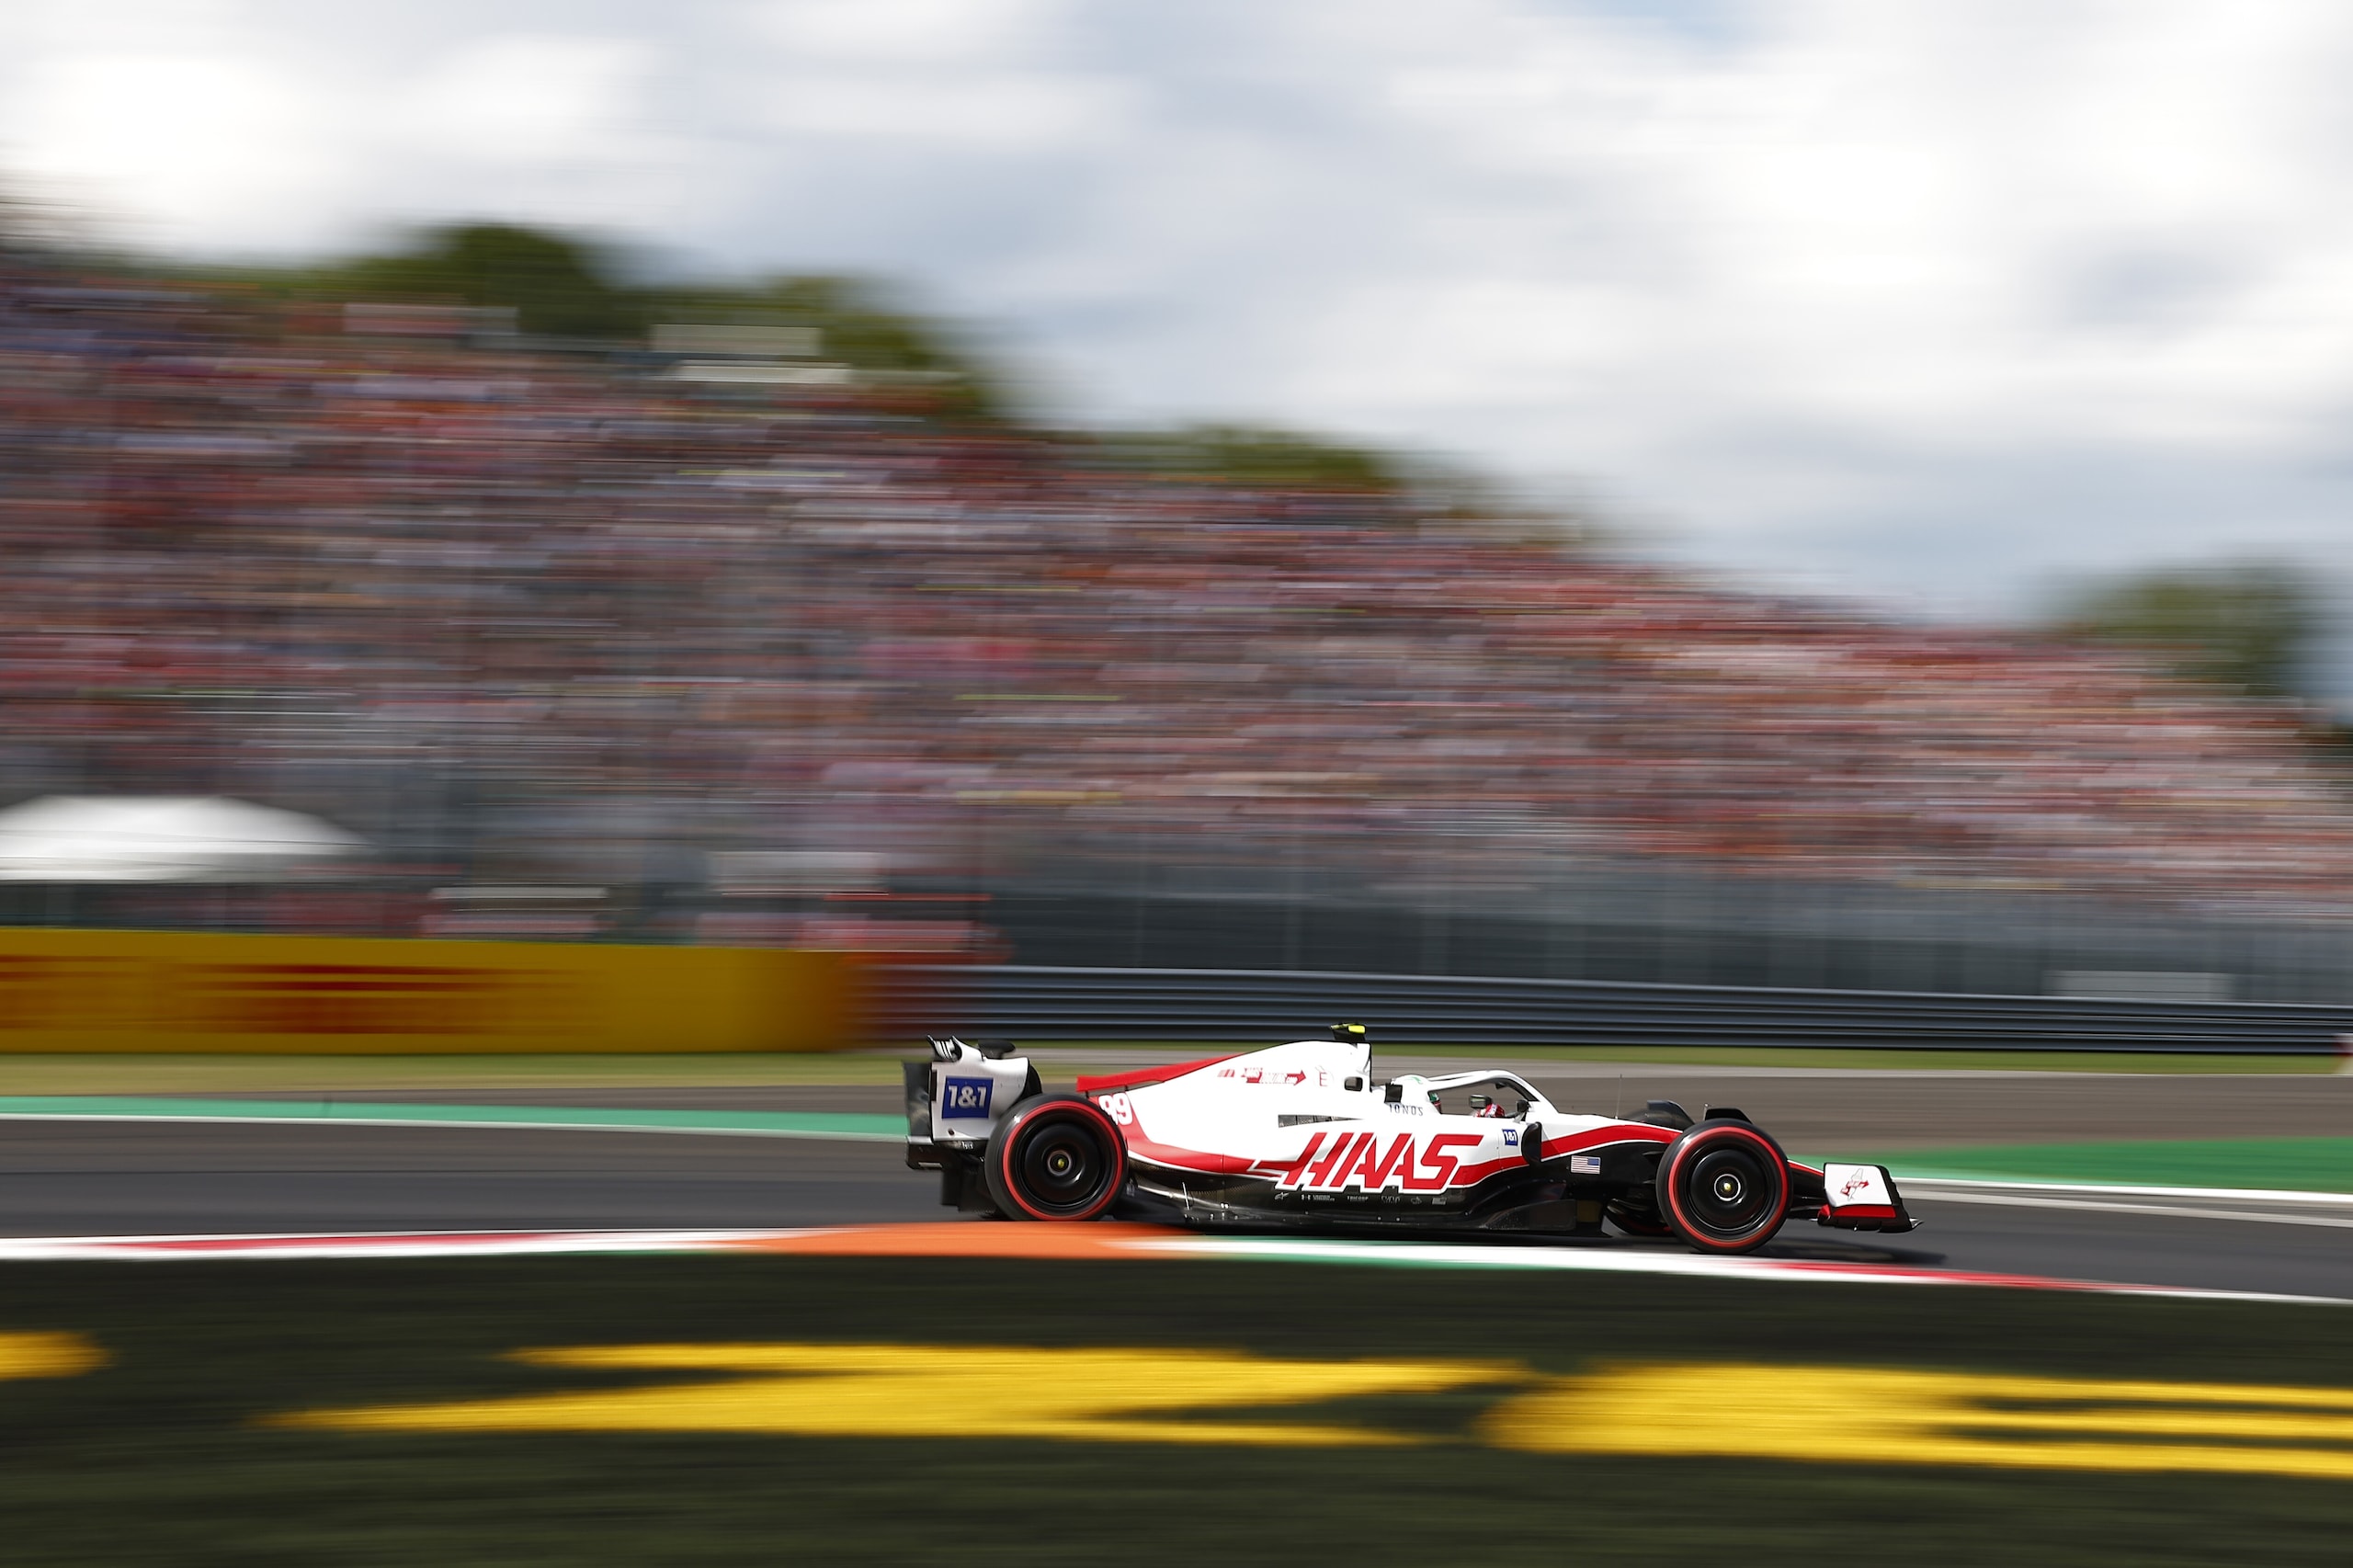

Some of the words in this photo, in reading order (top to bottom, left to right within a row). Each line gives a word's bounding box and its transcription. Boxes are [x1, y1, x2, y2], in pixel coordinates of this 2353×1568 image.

[948, 1085, 987, 1108] 1&1
[1098, 1092, 1133, 1125] 99
[1389, 1103, 1424, 1117] IONOS
[1503, 1131, 1518, 1142] 1&1
[1283, 1131, 1484, 1190] HAAS
